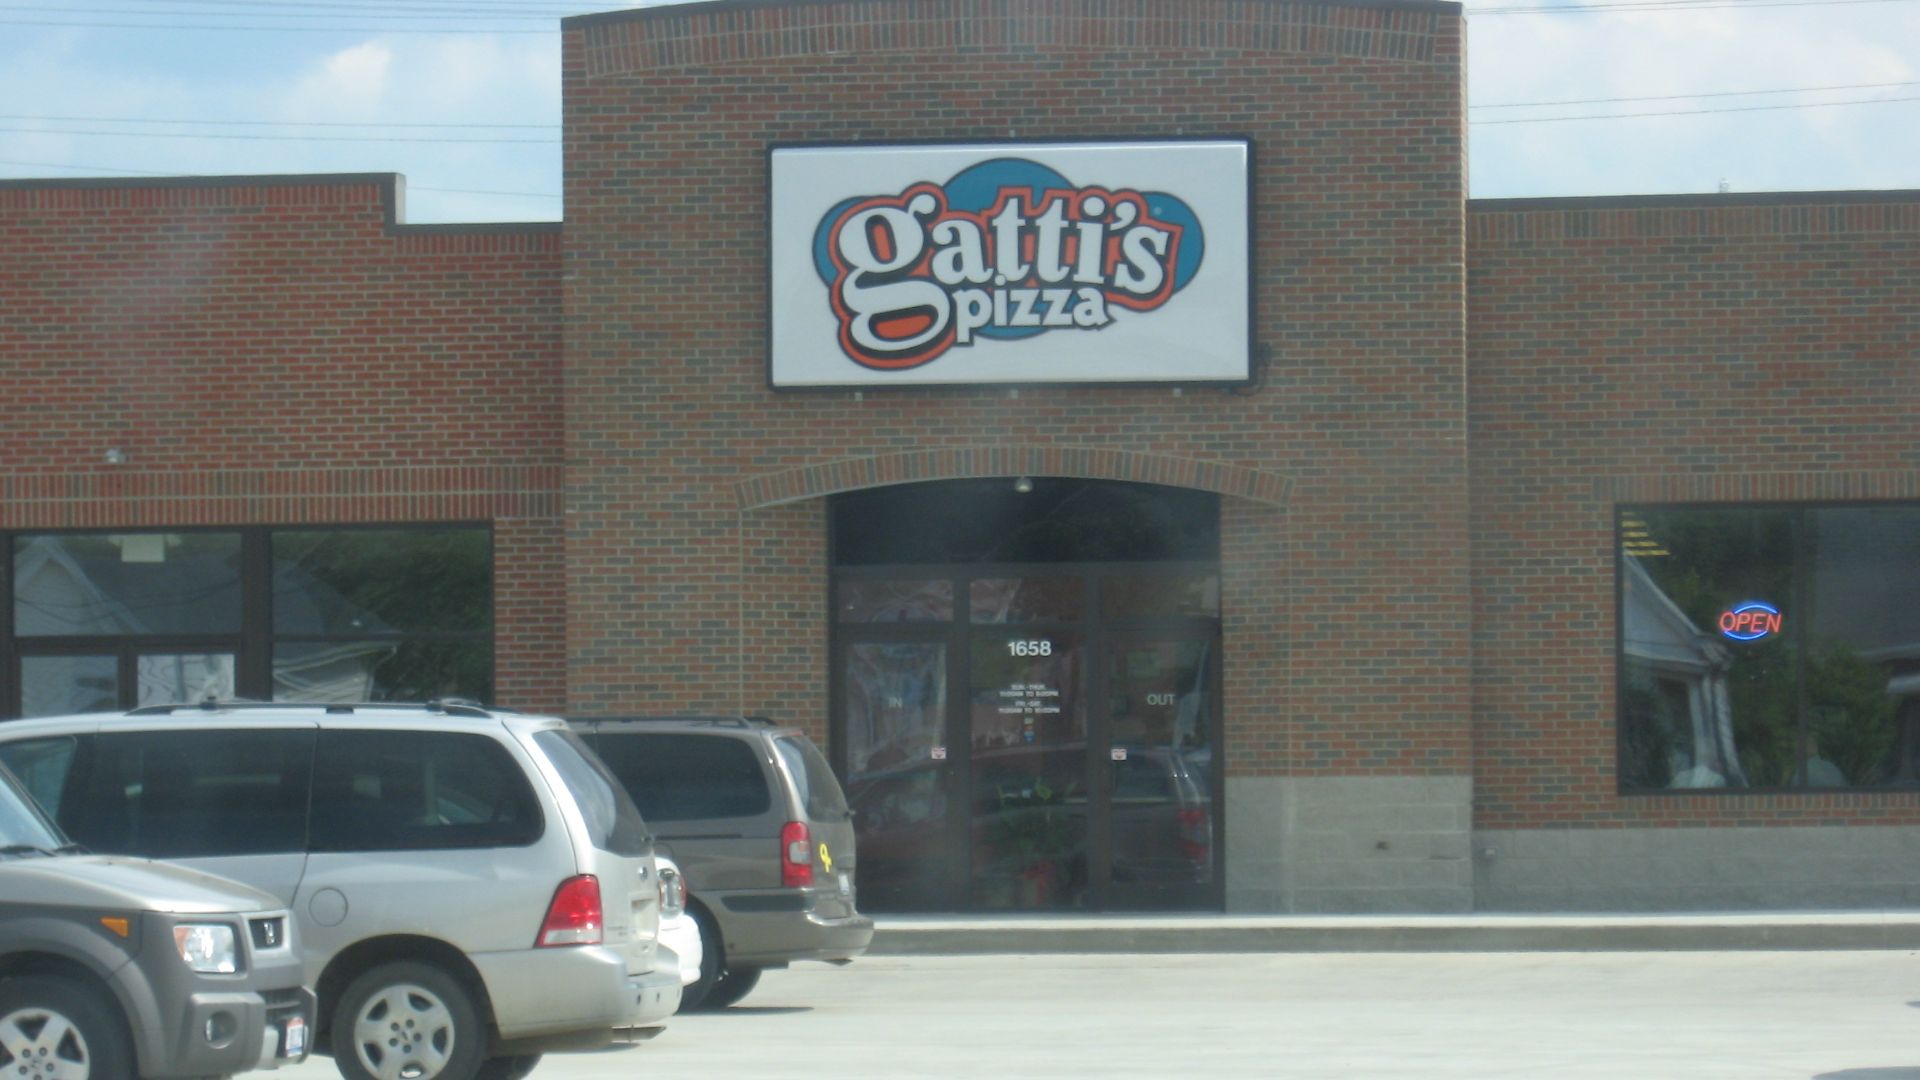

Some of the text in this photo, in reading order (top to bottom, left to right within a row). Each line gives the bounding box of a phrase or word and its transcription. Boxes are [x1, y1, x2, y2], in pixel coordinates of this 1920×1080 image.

[838, 193, 1170, 352] gatti's
[952, 273, 1111, 344] pizza
[1719, 611, 1782, 633] OPEN
[1007, 640, 1052, 657] 1658
[1147, 694, 1176, 706] OUT
